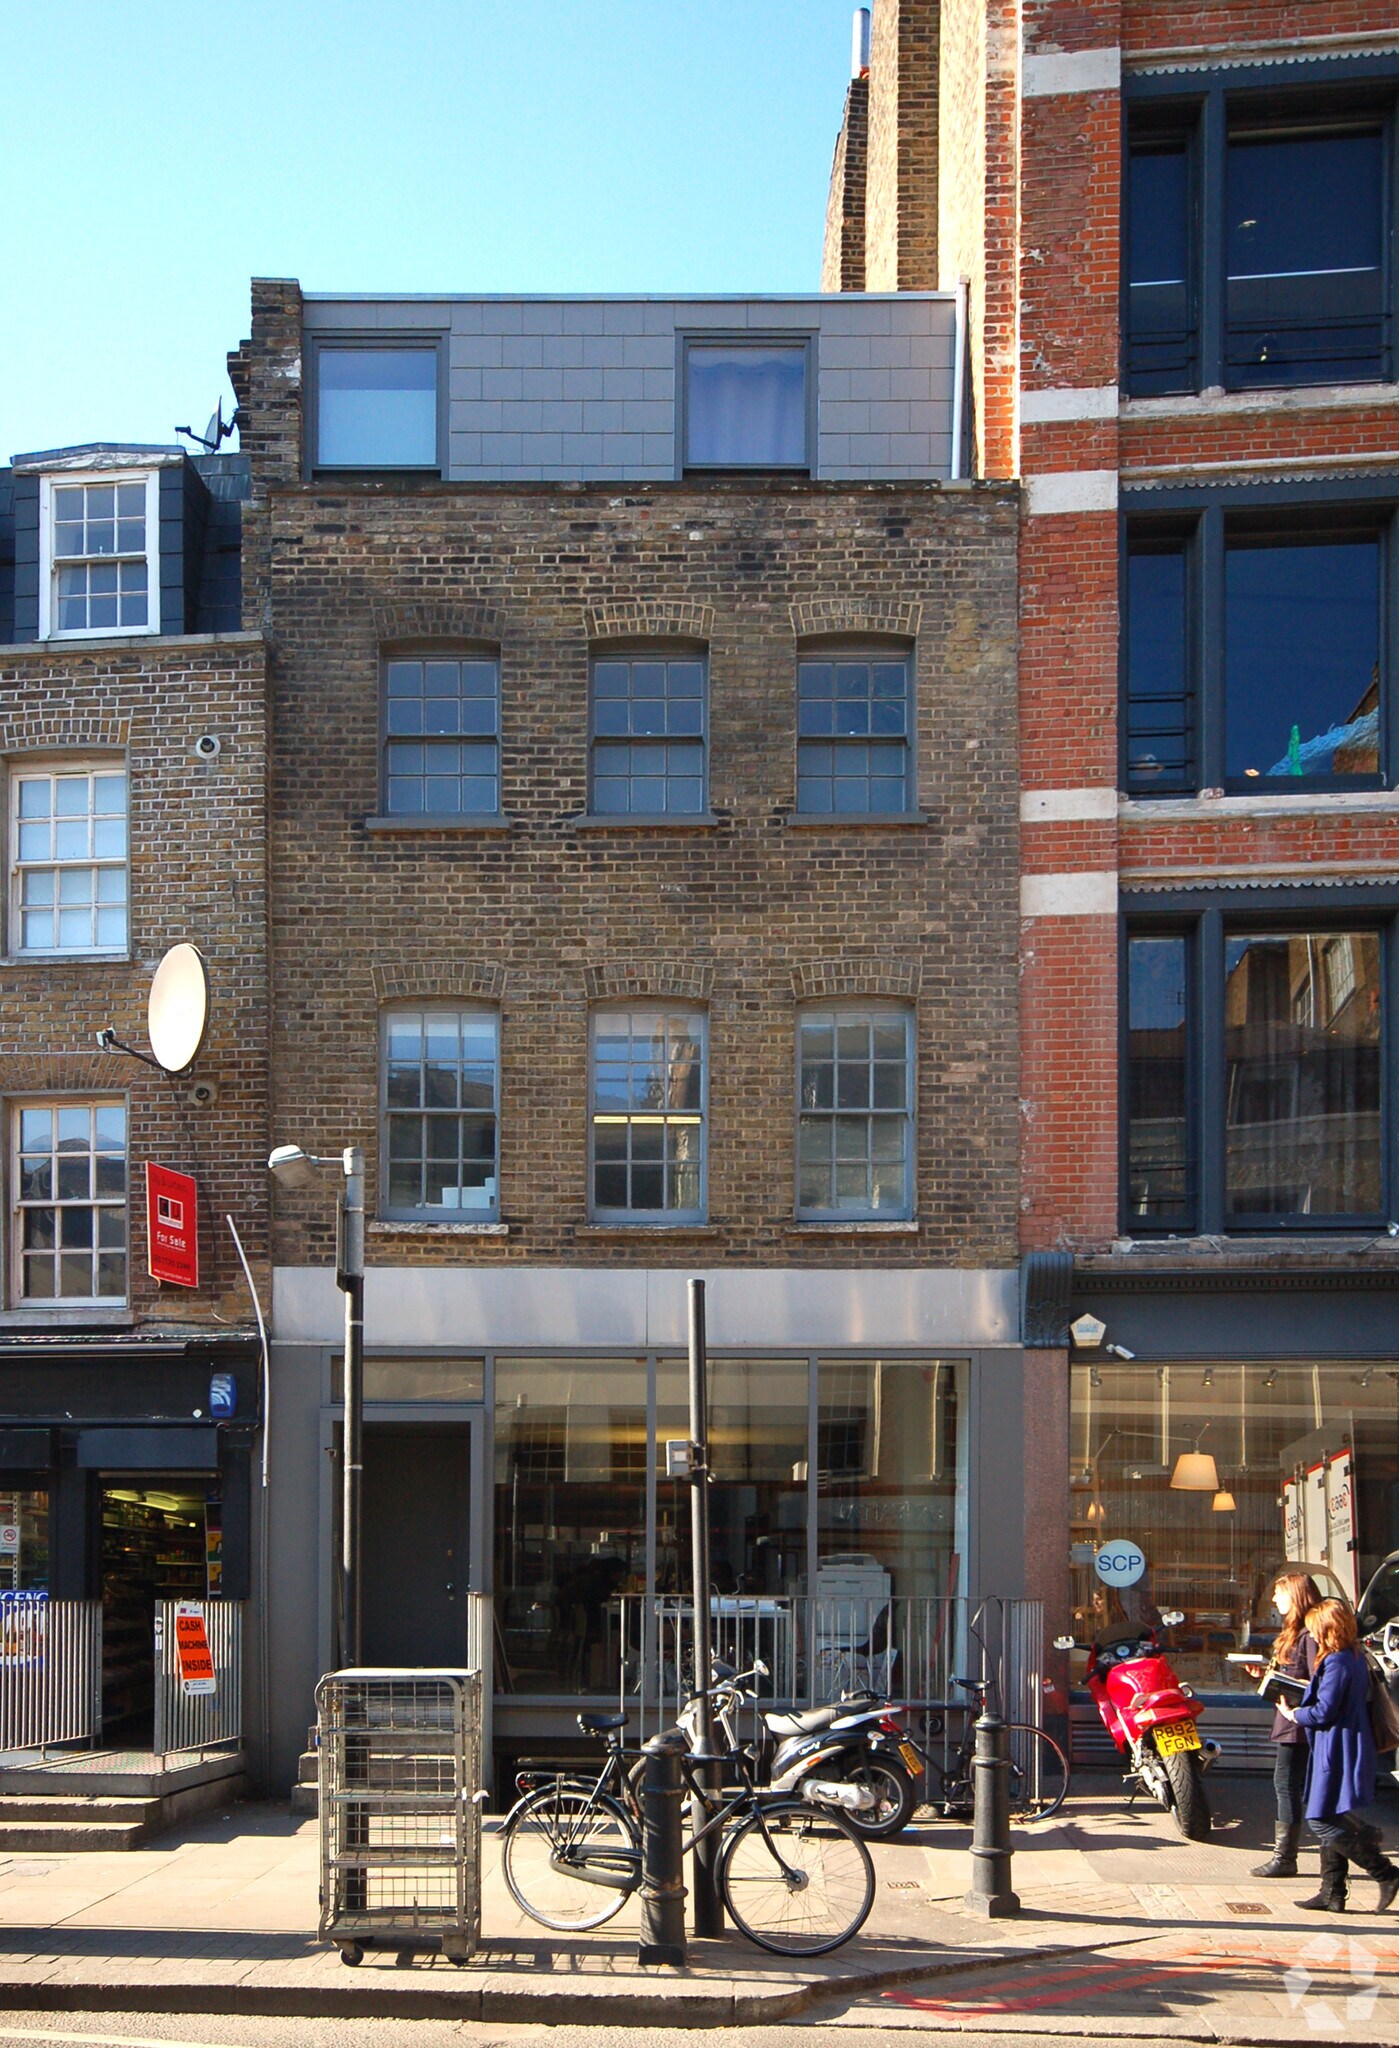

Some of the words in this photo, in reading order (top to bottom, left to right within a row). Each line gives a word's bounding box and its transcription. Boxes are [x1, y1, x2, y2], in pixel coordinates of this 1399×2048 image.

[157, 1231, 168, 1243] For
[169, 1235, 186, 1248] Sale
[1098, 1555, 1142, 1571] SCP
[180, 1620, 202, 1632] CASH
[178, 1640, 209, 1650] MACHINE
[182, 1660, 212, 1671] INSIDE
[1155, 1721, 1195, 1740] R892
[1164, 1735, 1194, 1752] FGN
